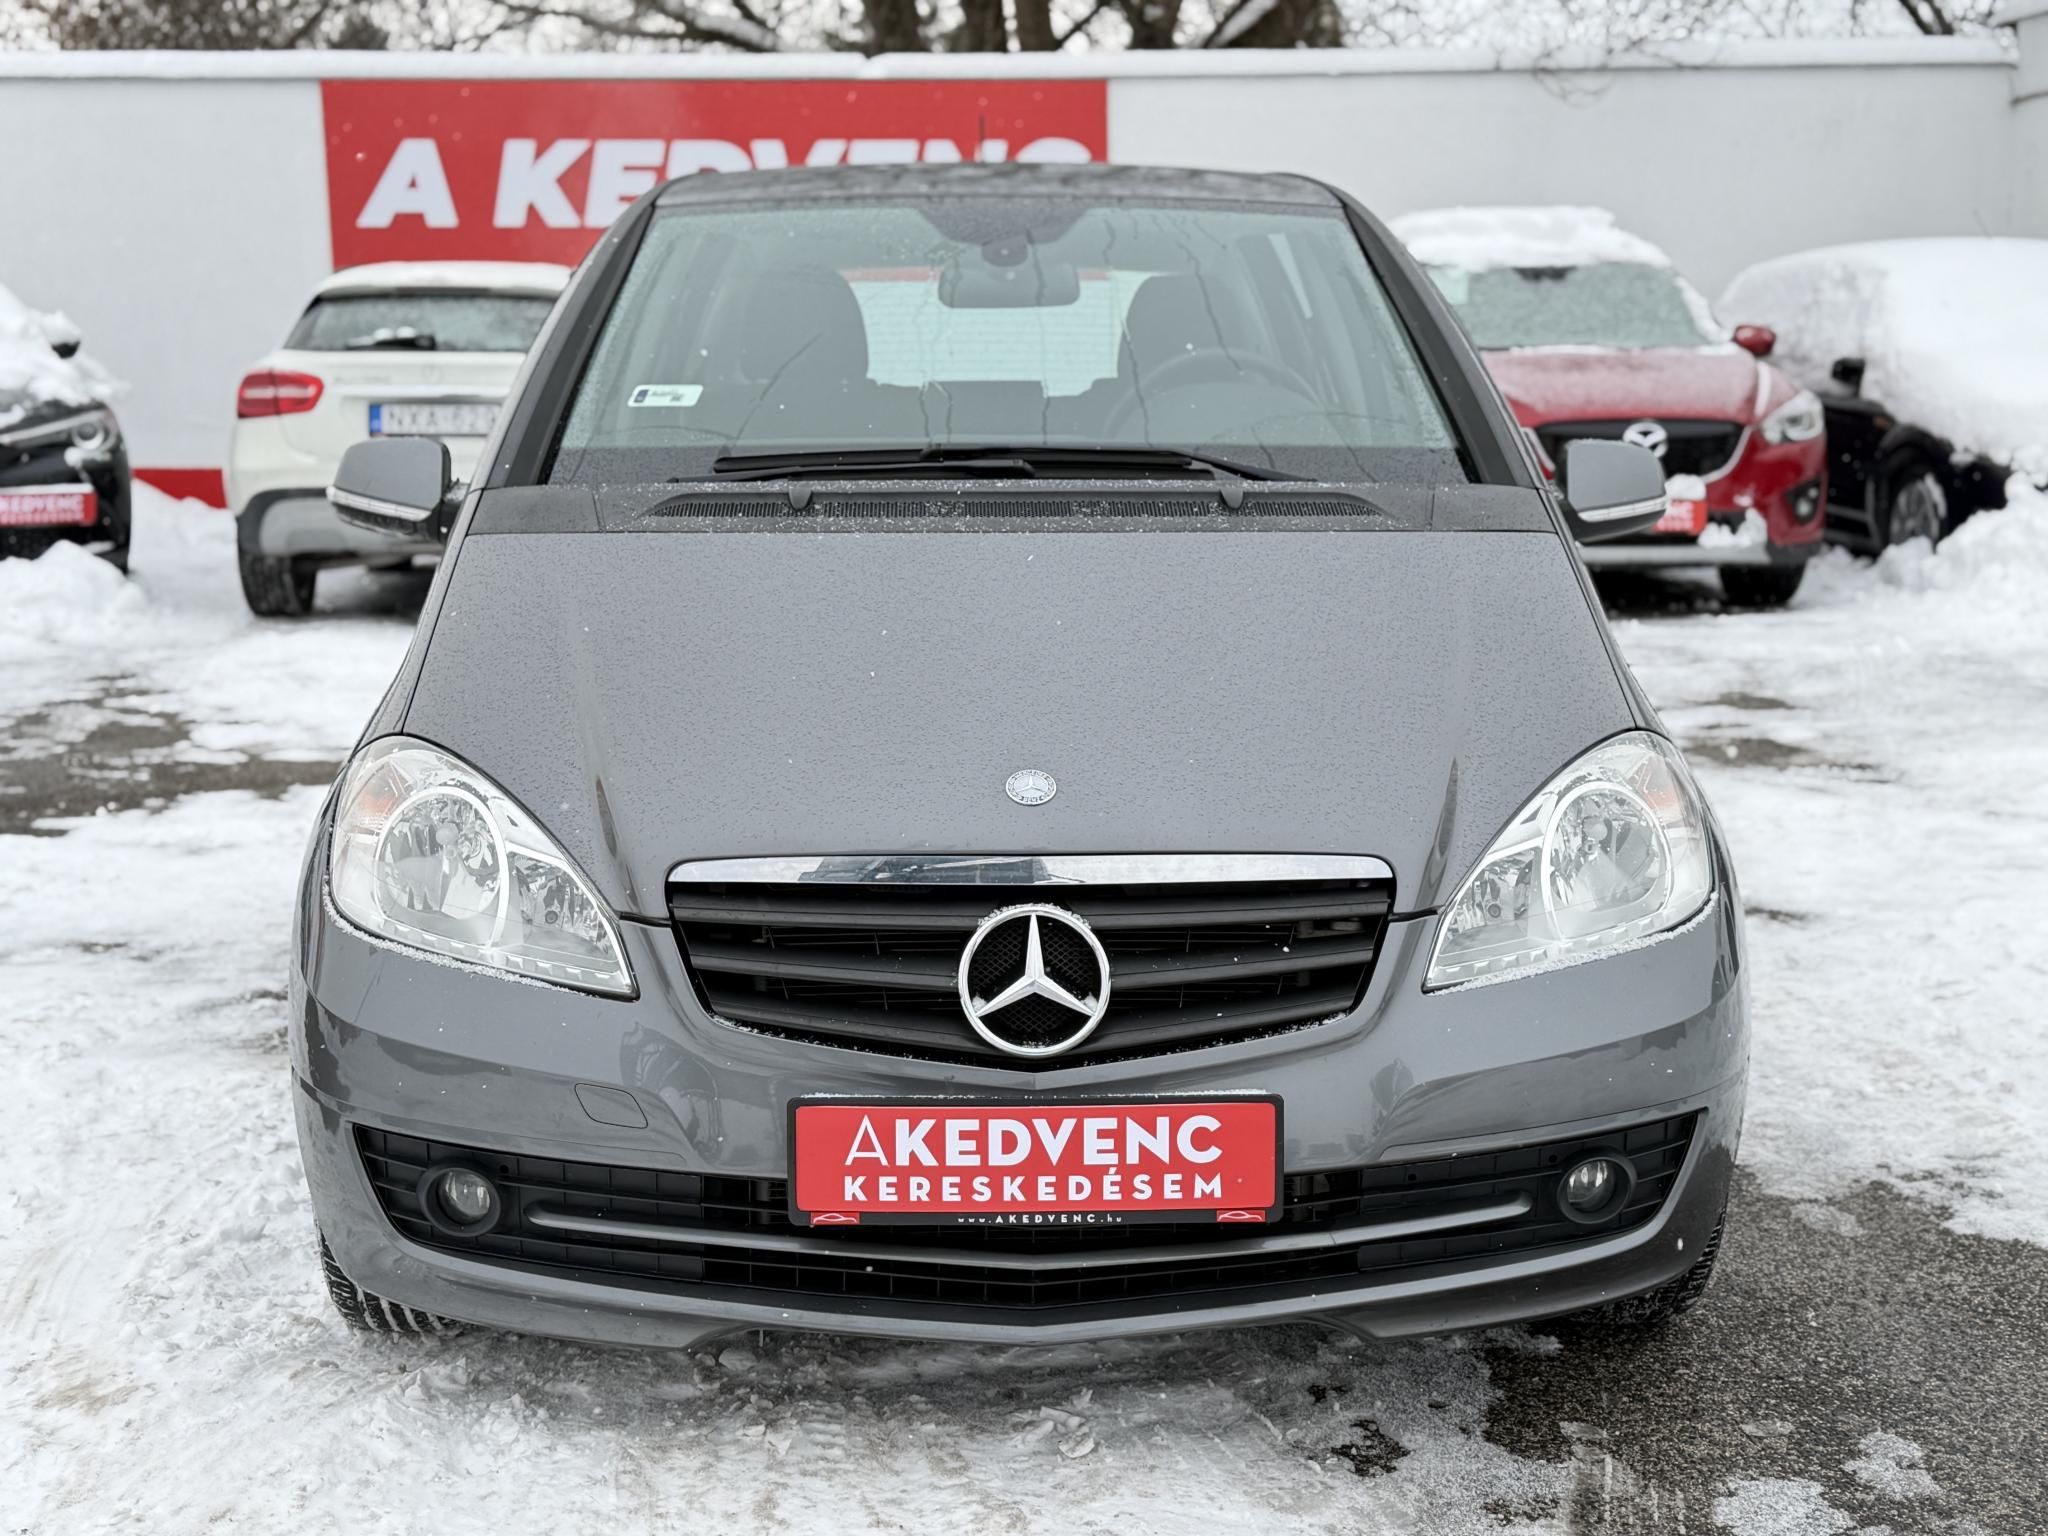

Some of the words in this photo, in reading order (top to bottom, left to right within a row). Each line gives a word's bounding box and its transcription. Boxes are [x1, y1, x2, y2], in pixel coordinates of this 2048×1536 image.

[355, 137, 460, 229] A
[844, 1114, 1223, 1167] AKEDVENC
[844, 1167, 1223, 1202] KERESKEDÉSEM
[957, 1213, 1123, 1225] www.AKEDVENC.hu
